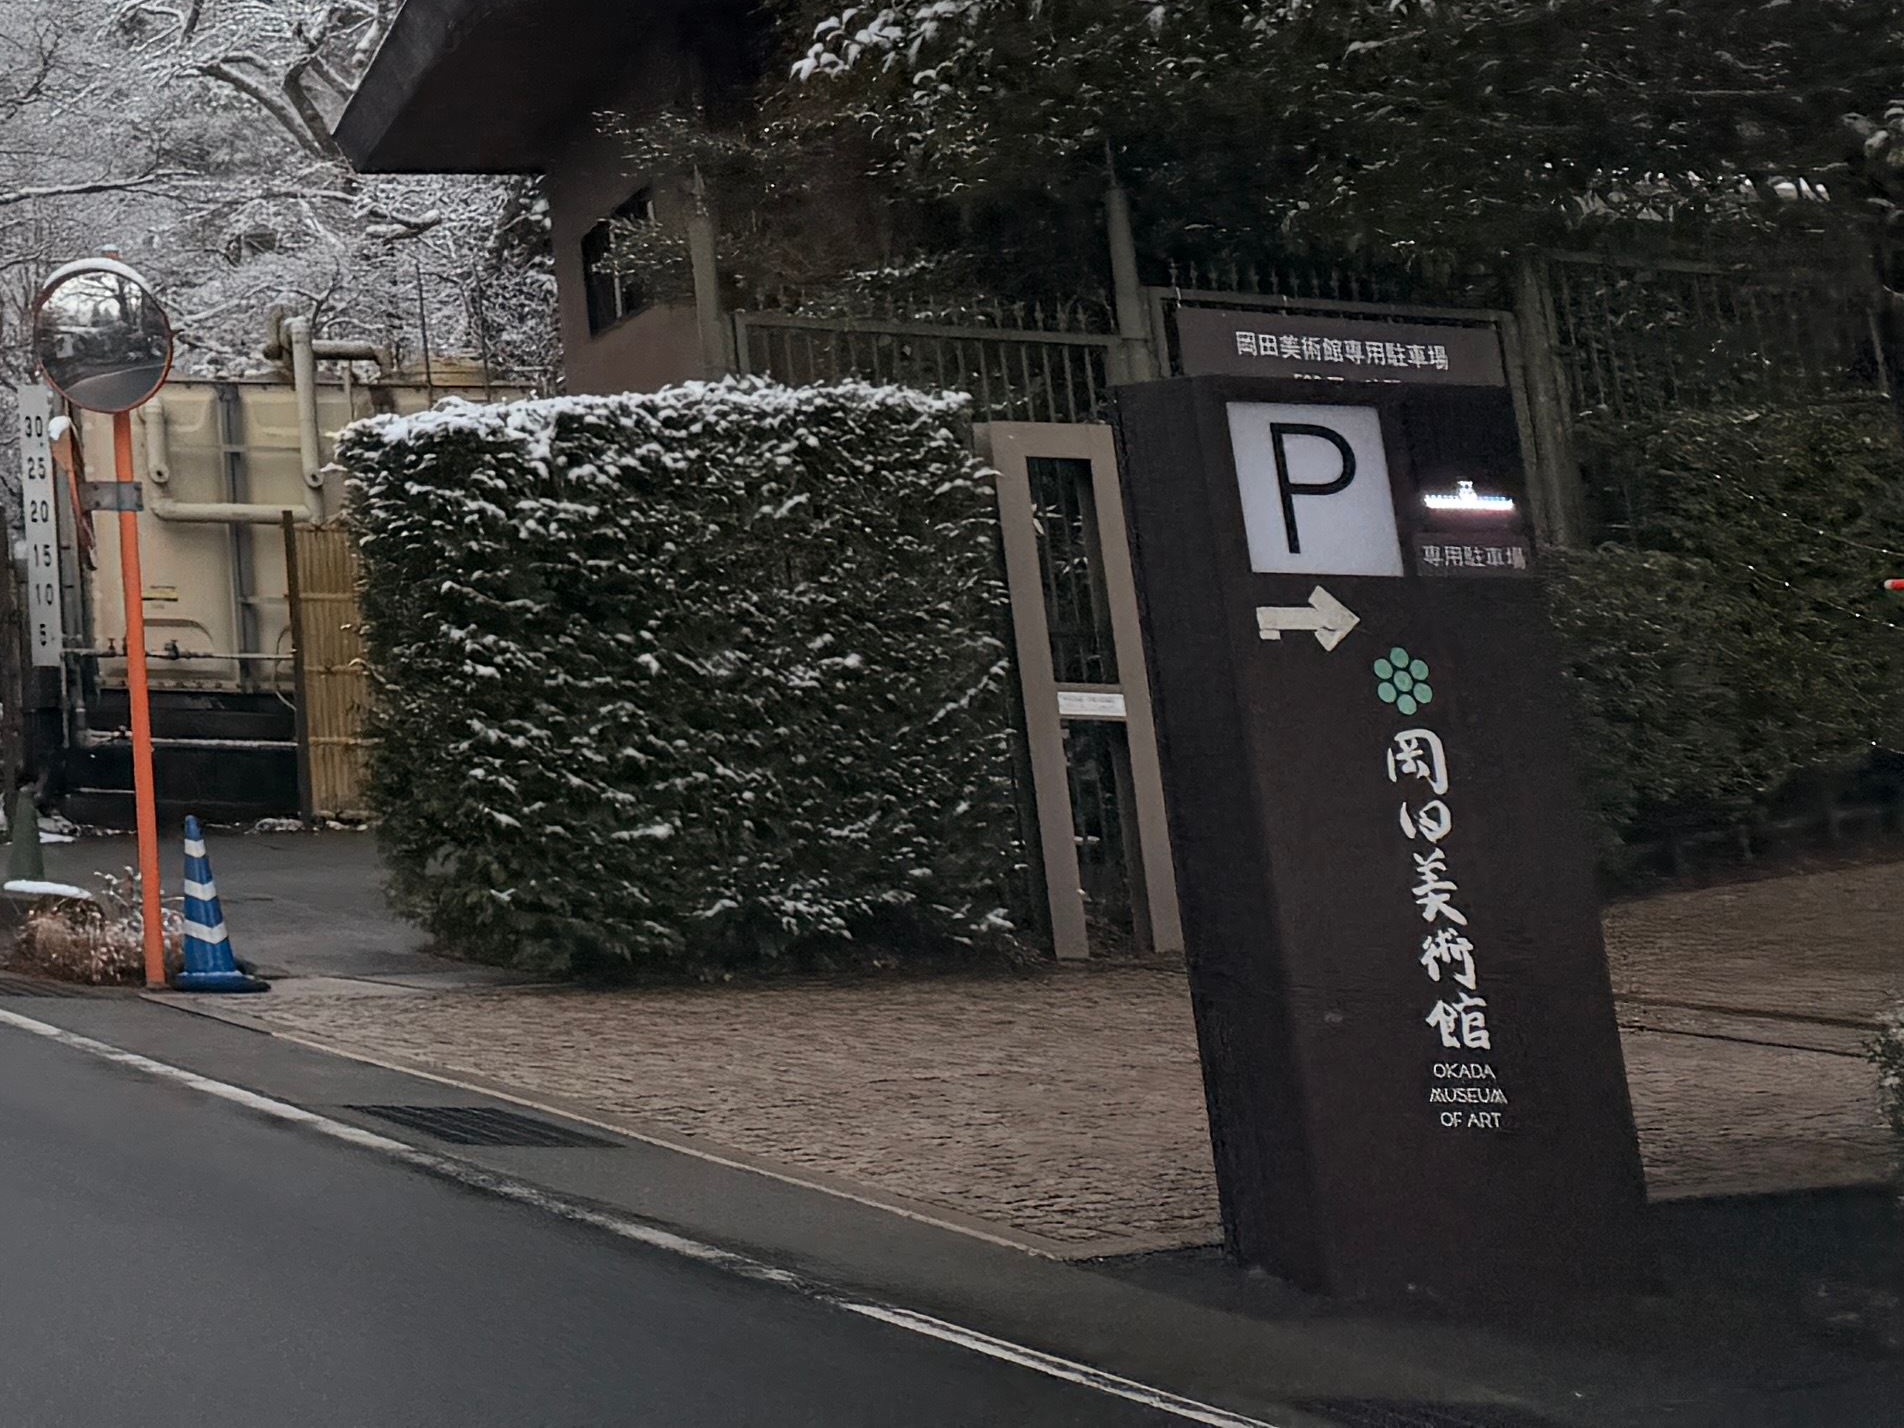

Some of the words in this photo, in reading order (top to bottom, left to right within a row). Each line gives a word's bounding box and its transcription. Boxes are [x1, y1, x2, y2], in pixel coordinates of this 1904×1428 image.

[1235, 330, 1450, 372] 岡田美術館専用駐車場
[24, 415, 43, 438] 30
[27, 456, 46, 480] 25
[1269, 422, 1357, 555] P
[30, 500, 49, 523] 20
[33, 544, 52, 567] 15
[1422, 544, 1527, 571] 専用駐車場
[35, 583, 54, 606] 10
[39, 623, 47, 646] 5
[1433, 1063, 1497, 1080] OKADA
[1429, 1087, 1509, 1104] MUSEUM
[1440, 1112, 1463, 1128] OF
[1467, 1112, 1502, 1129] ART
